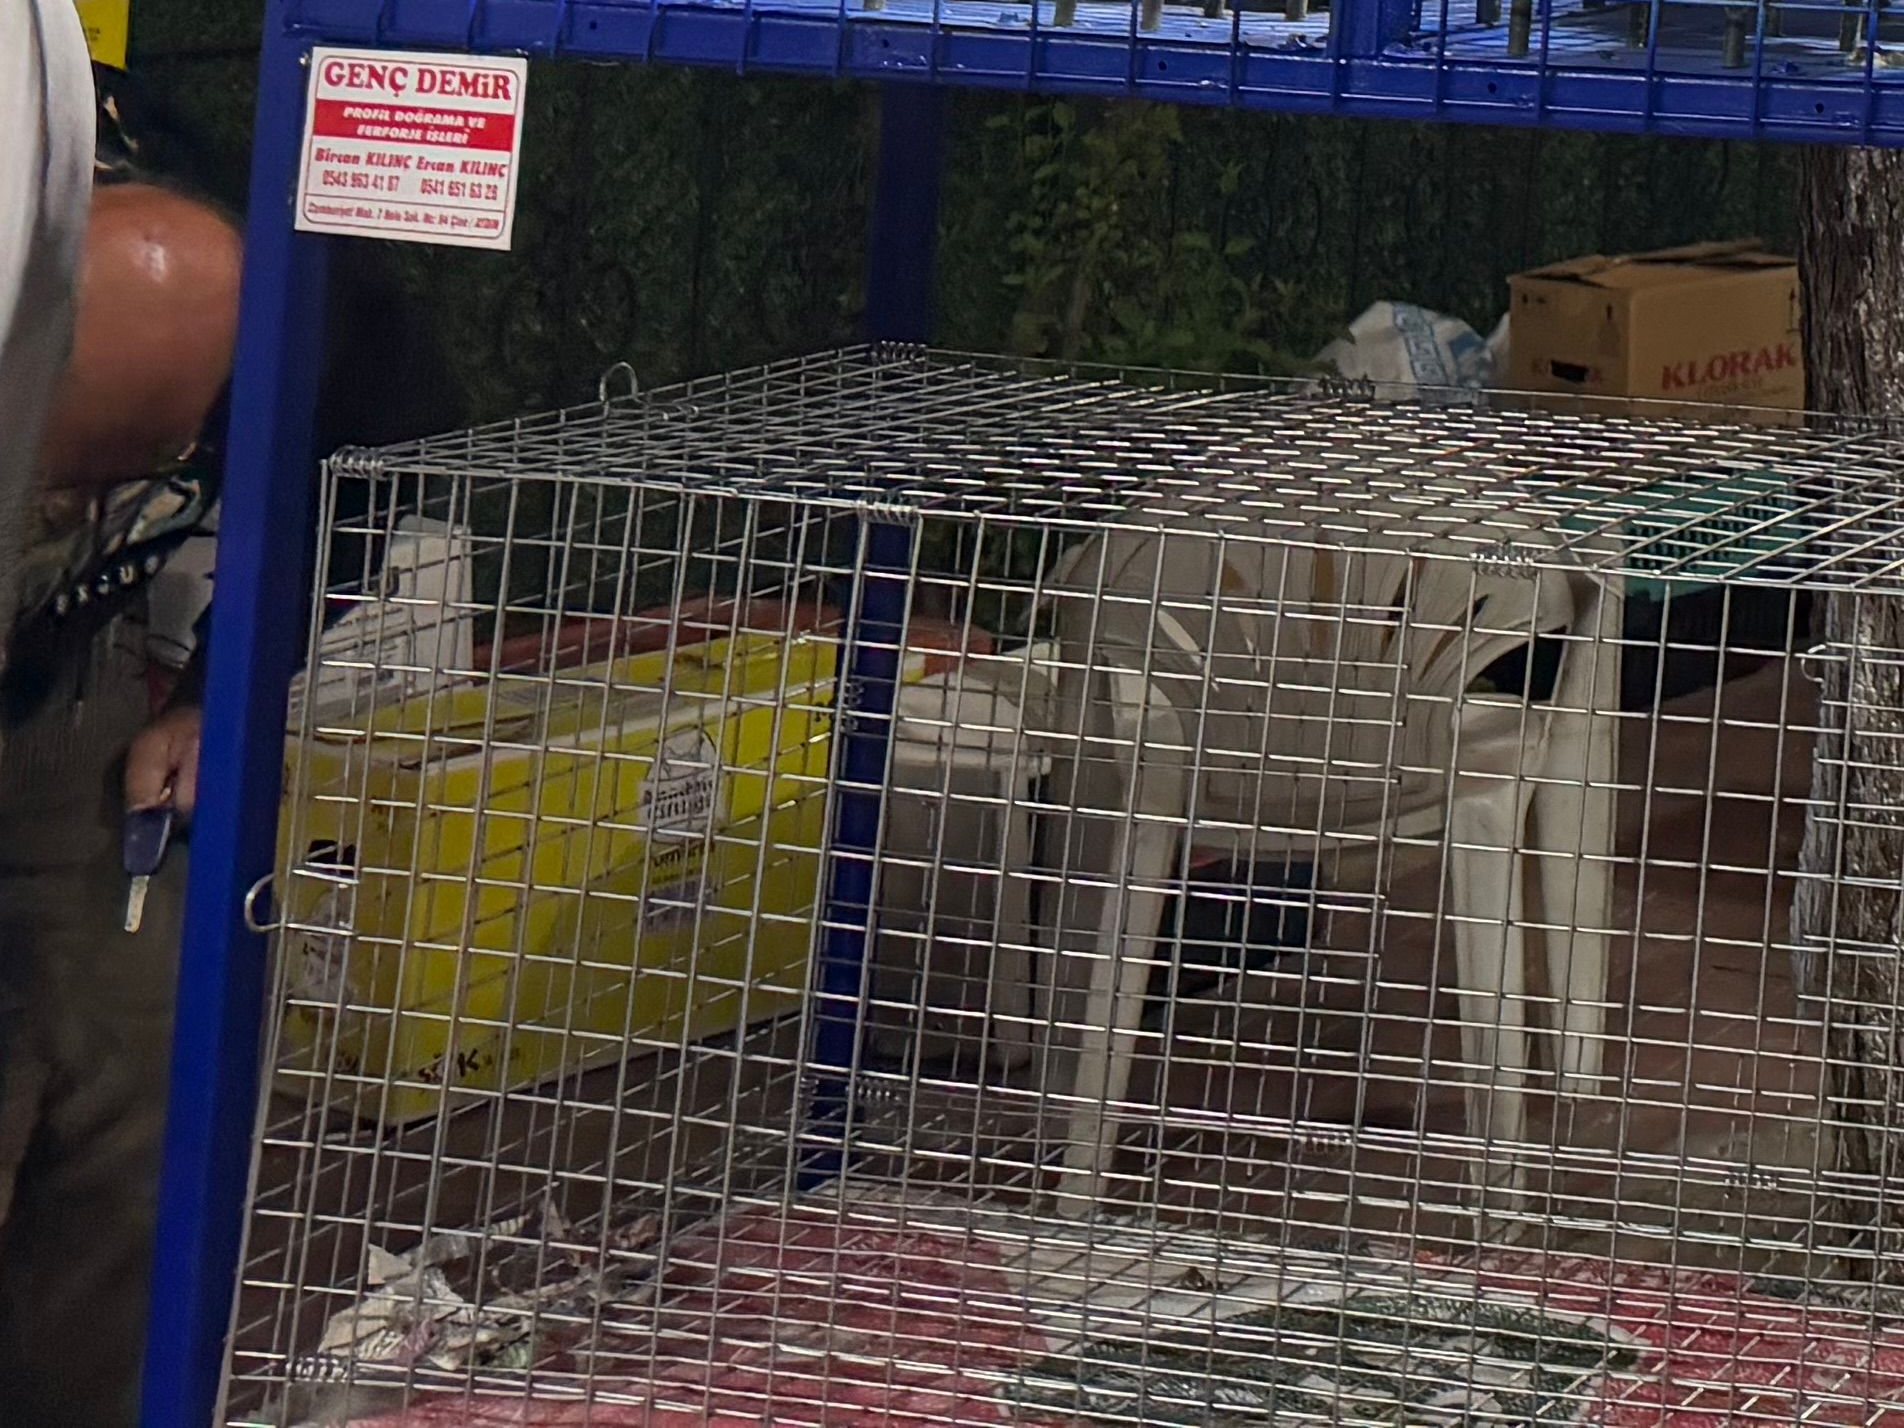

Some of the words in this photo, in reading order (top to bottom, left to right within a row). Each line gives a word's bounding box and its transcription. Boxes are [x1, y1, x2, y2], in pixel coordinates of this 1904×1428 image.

[324, 61, 409, 98] GENÇ
[315, 147, 360, 165] Bircan
[1661, 342, 1796, 391] KLORAK
